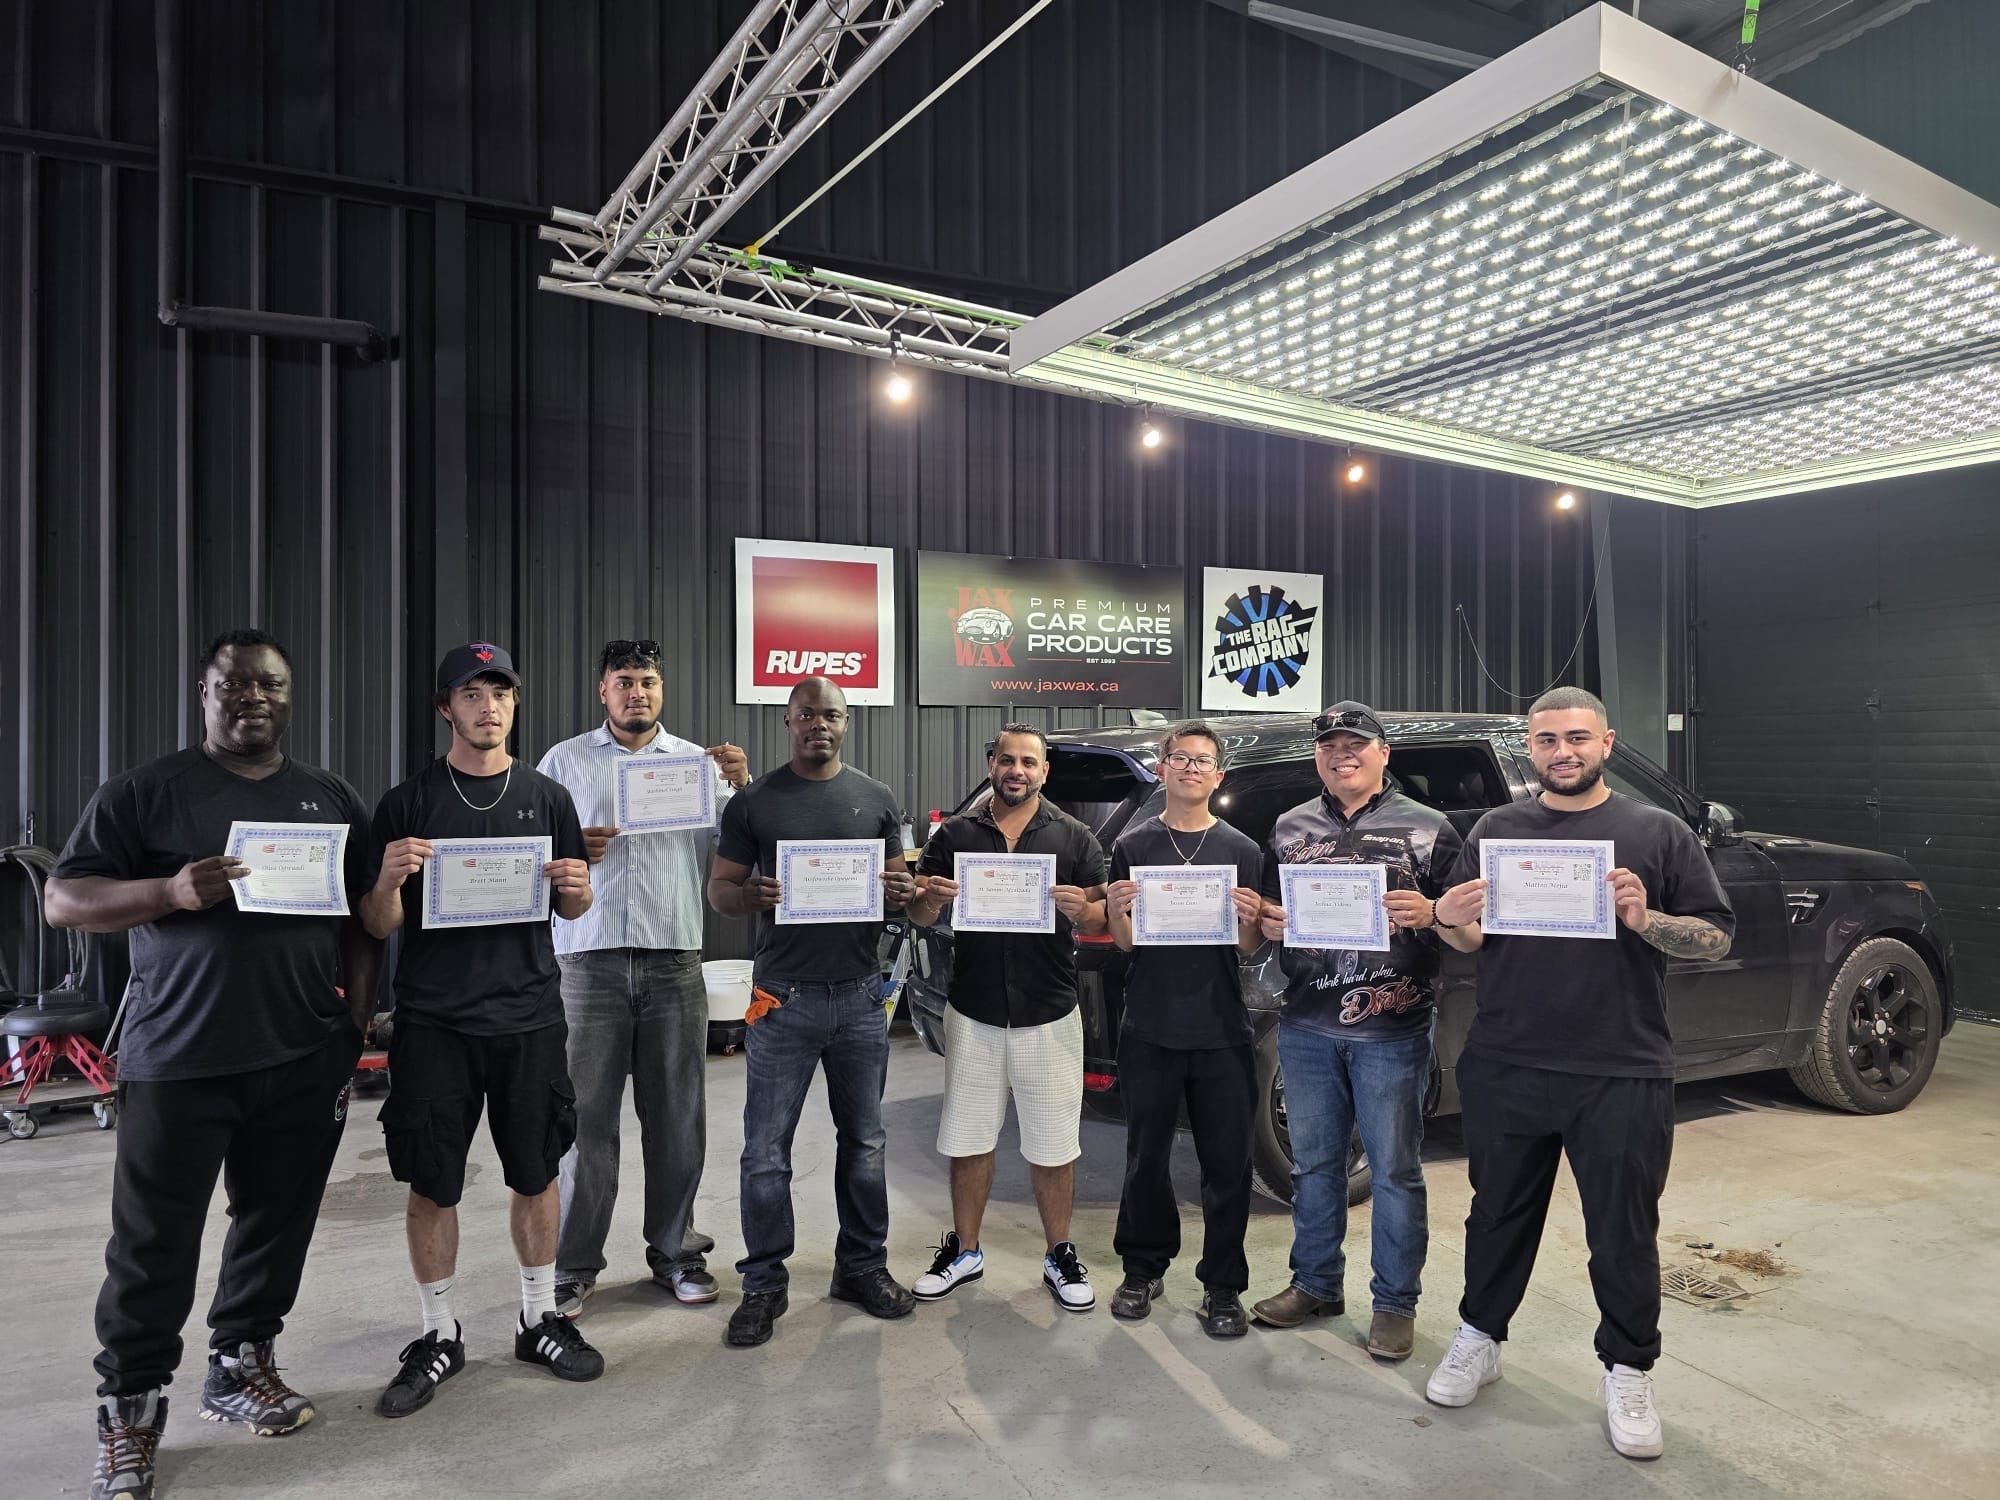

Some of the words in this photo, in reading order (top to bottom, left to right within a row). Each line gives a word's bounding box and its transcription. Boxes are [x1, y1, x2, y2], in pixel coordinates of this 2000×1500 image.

[948, 586, 1015, 619] JAX
[1030, 597, 1171, 614] PREMIUM
[1027, 612, 1087, 632] CAR
[1097, 614, 1171, 635] CARE
[1226, 629, 1252, 646] THE
[1251, 613, 1314, 644] RAG
[951, 630, 1016, 668] WAX
[1027, 633, 1173, 656] PRODUCTS
[1213, 631, 1310, 676] COMPANY
[765, 650, 863, 676] RUPES
[990, 678, 1119, 693] www.jaxwax.ca
[1310, 974, 1341, 990] Work
[1370, 964, 1398, 982] play
